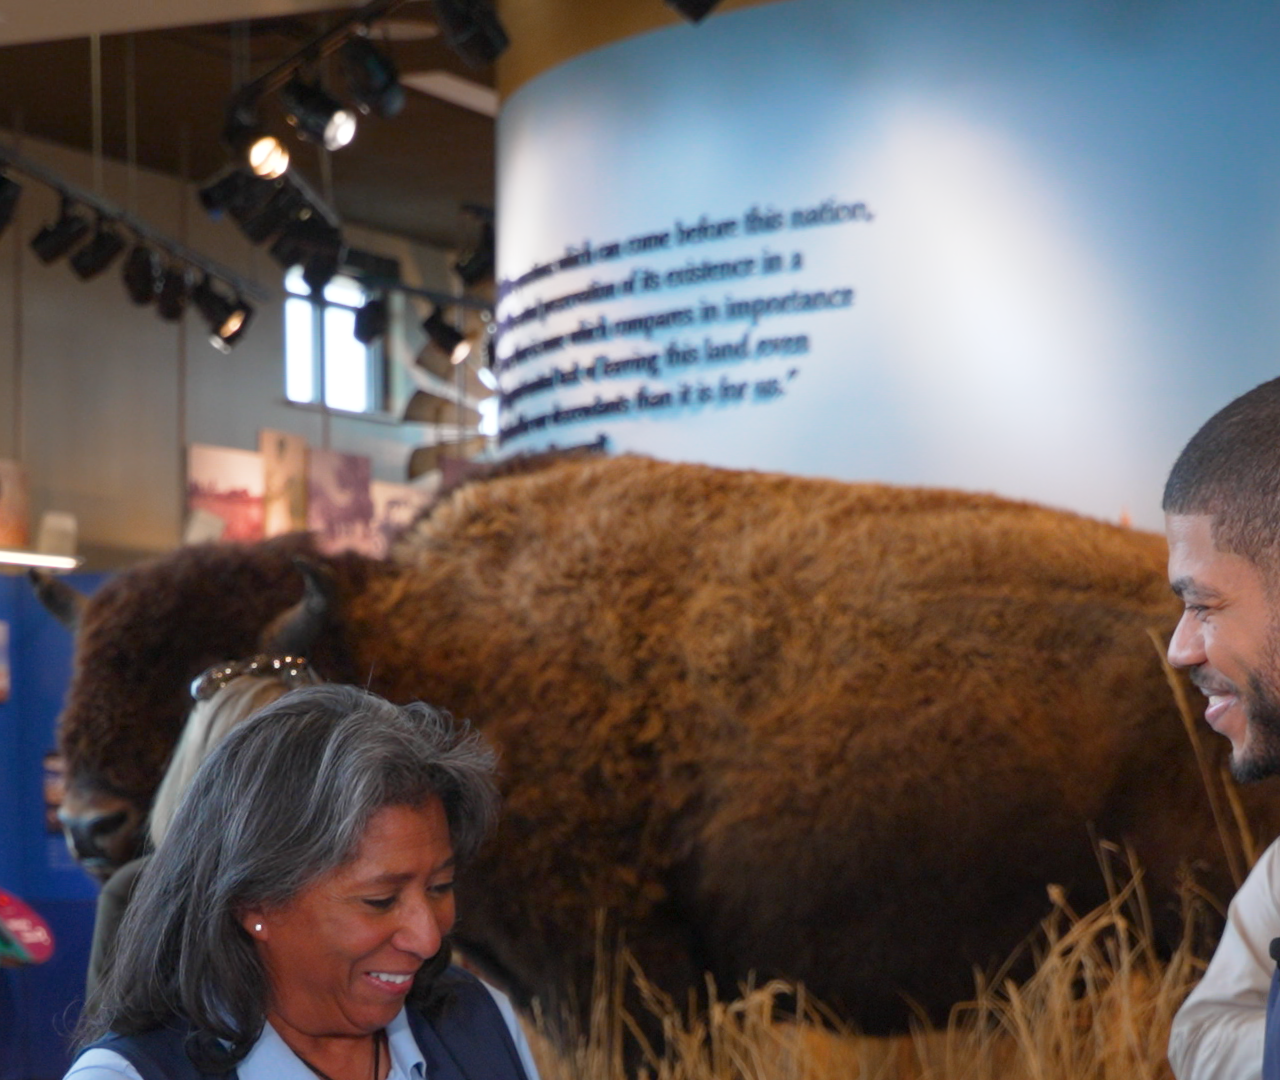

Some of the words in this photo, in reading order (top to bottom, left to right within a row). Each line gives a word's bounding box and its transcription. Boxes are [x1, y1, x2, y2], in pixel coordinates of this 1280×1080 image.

[674, 217, 738, 247] before
[744, 205, 784, 235] this
[789, 196, 874, 228] nation,
[761, 246, 782, 274] in
[790, 250, 803, 272] a
[699, 295, 719, 323] in
[724, 284, 856, 328] importance
[665, 340, 699, 369] this
[678, 382, 692, 405] it
[697, 379, 713, 402] is
[721, 373, 748, 399] for
